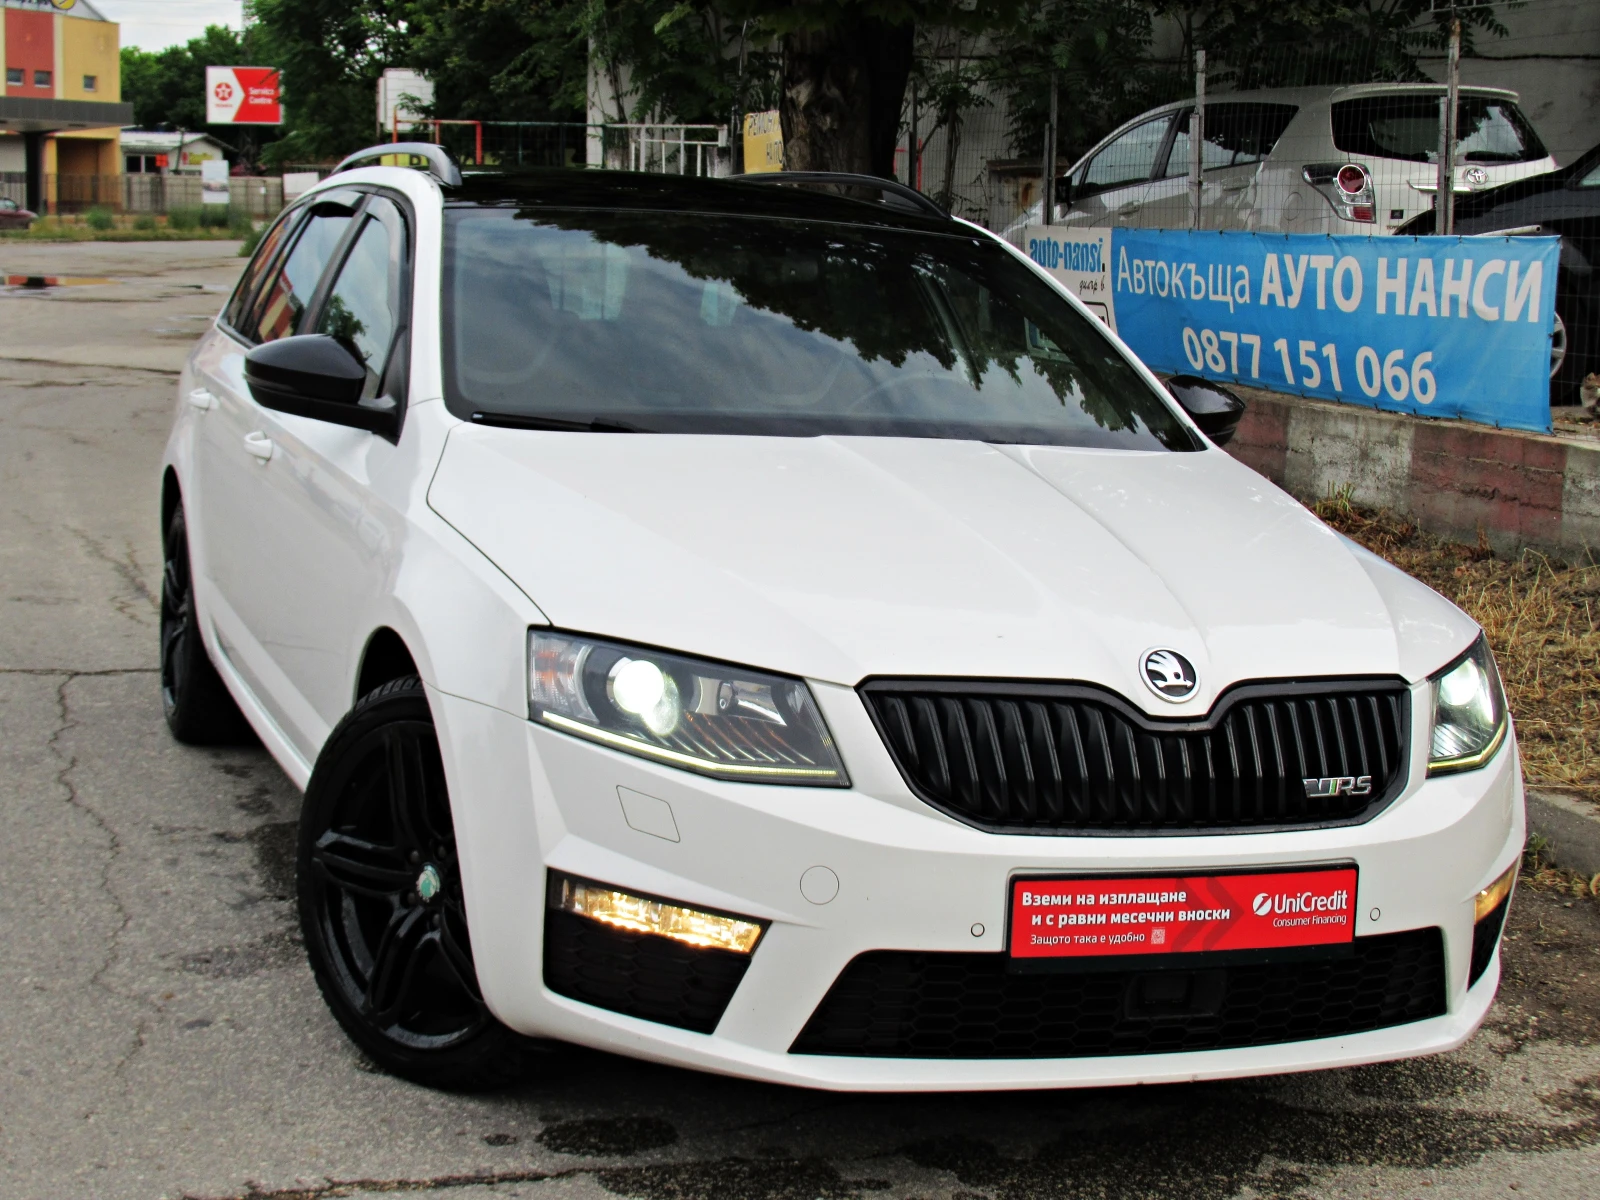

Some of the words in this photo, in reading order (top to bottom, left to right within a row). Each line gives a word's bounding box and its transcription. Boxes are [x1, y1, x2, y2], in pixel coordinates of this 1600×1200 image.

[1117, 246, 1251, 314] Автокъща
[1260, 253, 1363, 313] АУТО
[1376, 257, 1543, 323] НАНСИ
[1183, 326, 1261, 379] 0877
[1273, 338, 1343, 391] 151
[1355, 346, 1438, 404] 066
[1022, 891, 1072, 906] Вземи
[1076, 894, 1095, 905] на
[1099, 891, 1187, 906] изплащане
[1274, 890, 1348, 914] UniCredit
[1032, 915, 1042, 926] и
[1046, 914, 1054, 925] с
[1058, 913, 1107, 928] равни
[1110, 910, 1174, 924] месечни
[1178, 908, 1231, 922] вноски
[1273, 916, 1310, 928] Consumer
[1312, 913, 1347, 925] Financing
[1030, 934, 1071, 946] Защото
[1073, 935, 1097, 944] така
[1100, 935, 1106, 943] е
[1108, 932, 1145, 945] удобно
